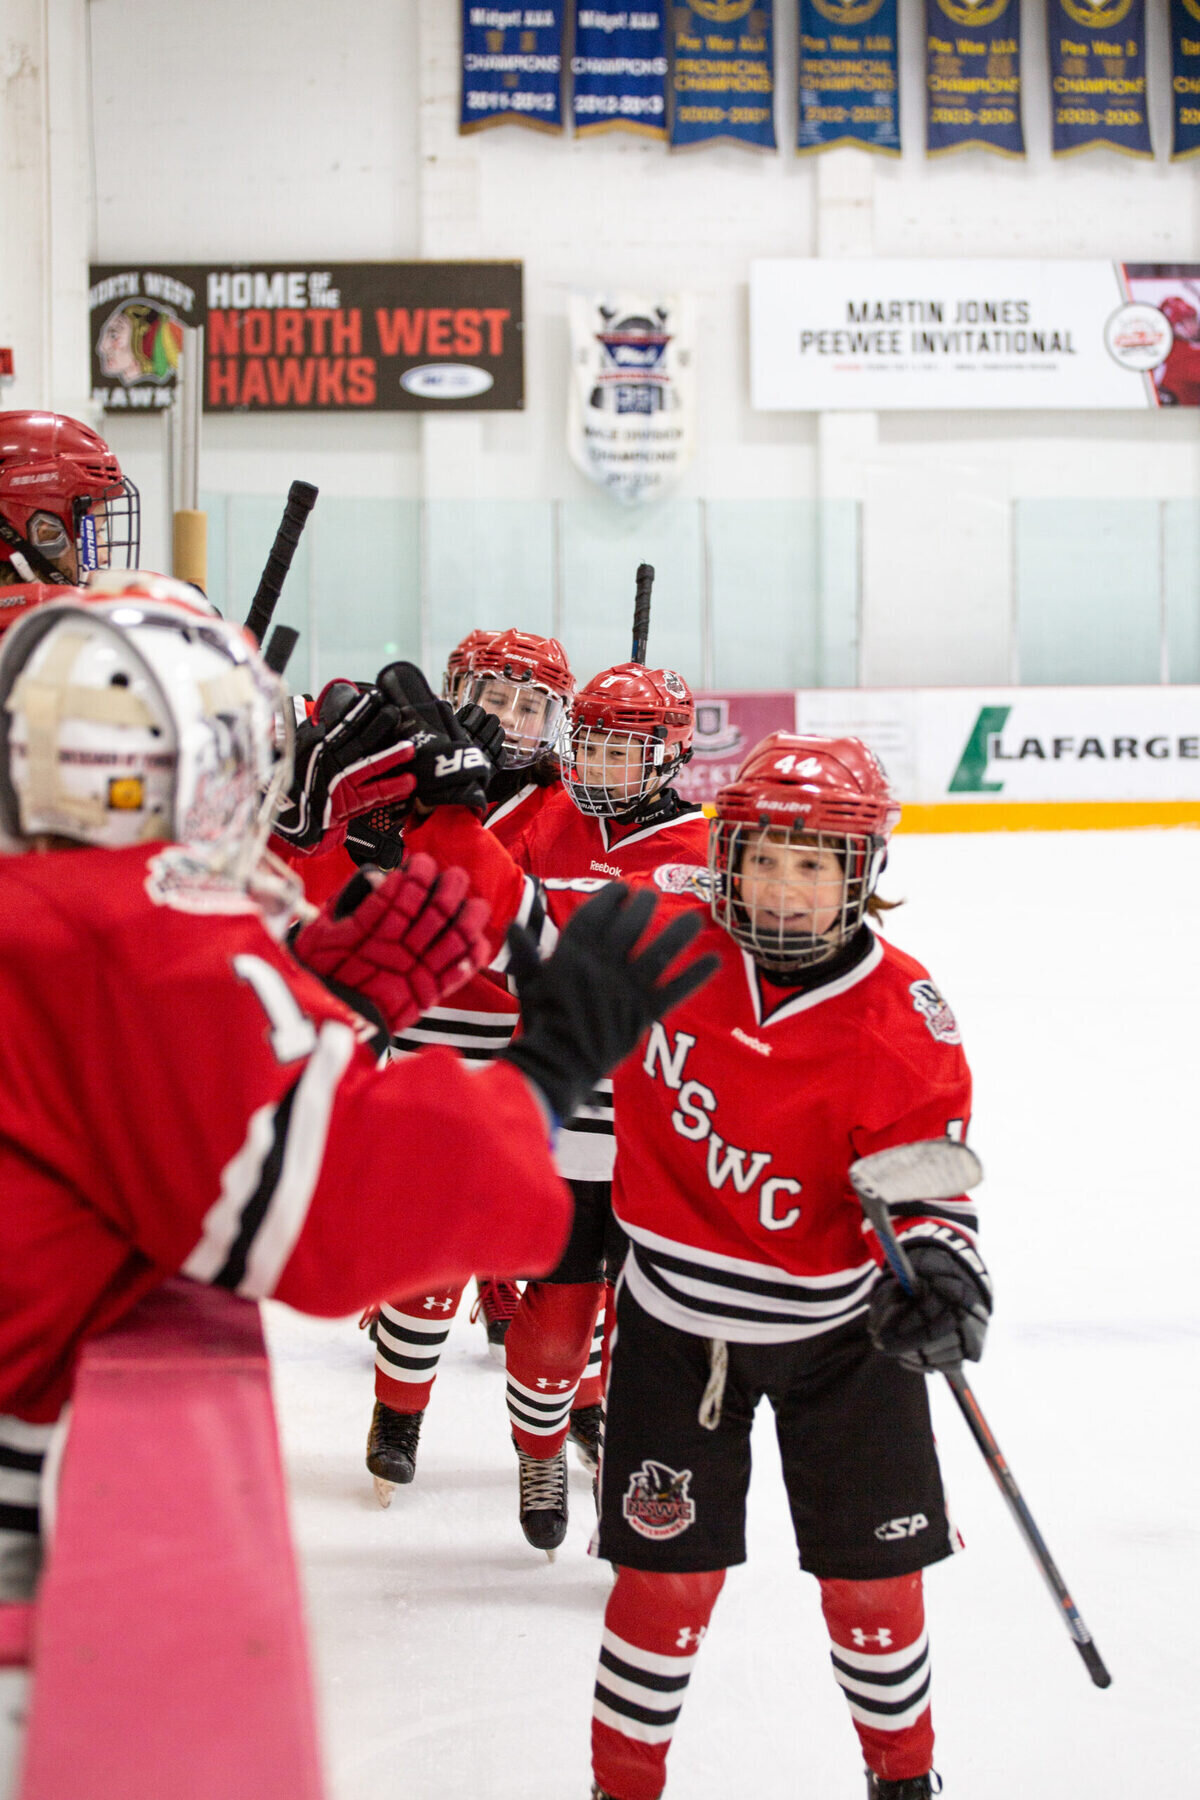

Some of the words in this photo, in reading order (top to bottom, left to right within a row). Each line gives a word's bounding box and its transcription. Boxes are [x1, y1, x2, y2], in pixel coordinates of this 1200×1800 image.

[464, 54, 561, 73] CHAMPIONS
[570, 57, 668, 76] CHAMPIONS
[208, 272, 307, 309] HOME
[309, 272, 332, 290] OF
[310, 289, 340, 309] THE
[846, 301, 944, 324] MARTIN
[954, 301, 1030, 324] JONES
[209, 308, 362, 355] NORTH
[375, 308, 511, 356] WEST
[800, 330, 902, 355] PEEWEE
[912, 330, 1077, 355] INVITATIONAL
[209, 358, 376, 405] HAWKS
[93, 386, 172, 407] HAWK
[85, 519, 97, 570] BAUER
[992, 736, 1199, 760] LAFARGE
[774, 755, 822, 777] 44
[755, 799, 812, 813] BAUER
[589, 860, 623, 877] Reebok
[731, 1027, 773, 1056] Reebok
[642, 1020, 802, 1231] NSWC
